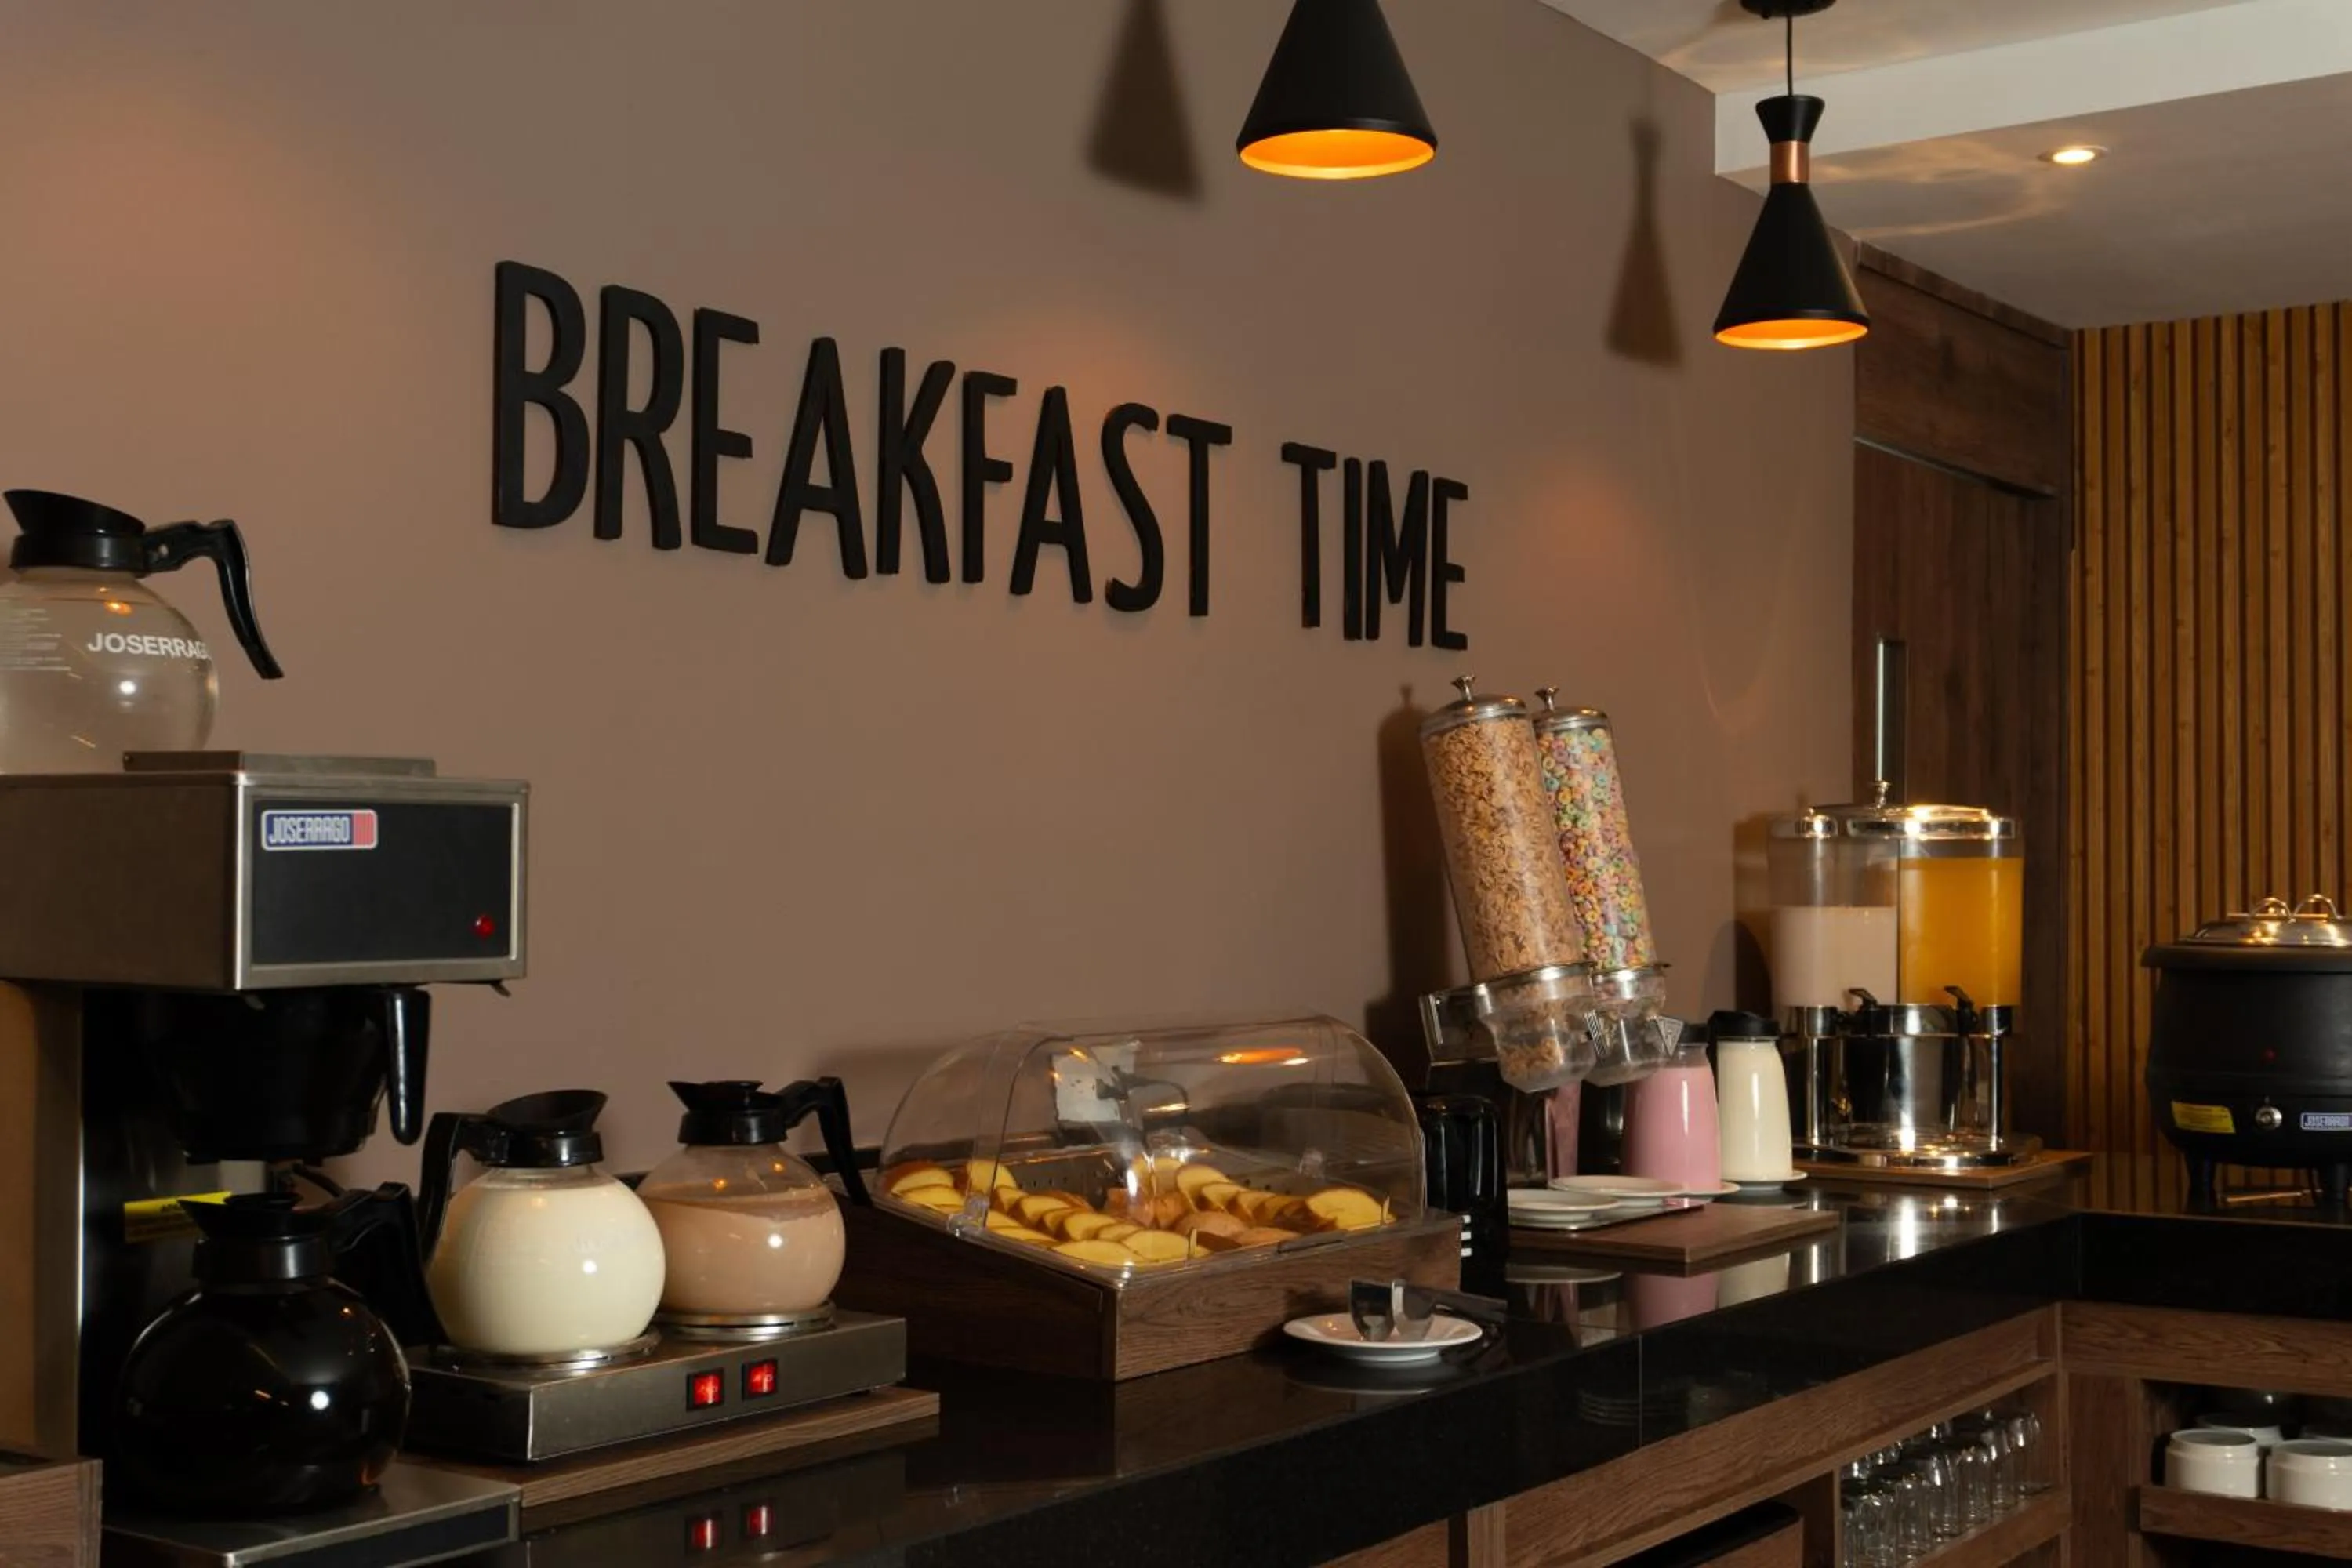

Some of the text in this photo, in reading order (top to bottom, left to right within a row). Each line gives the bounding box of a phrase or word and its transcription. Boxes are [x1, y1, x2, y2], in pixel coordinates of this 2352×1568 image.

[492, 260, 1468, 650] BREAKFAST TIME
[87, 632, 211, 659] JOSERRAG
[267, 815, 350, 844] JOSERRAGO
